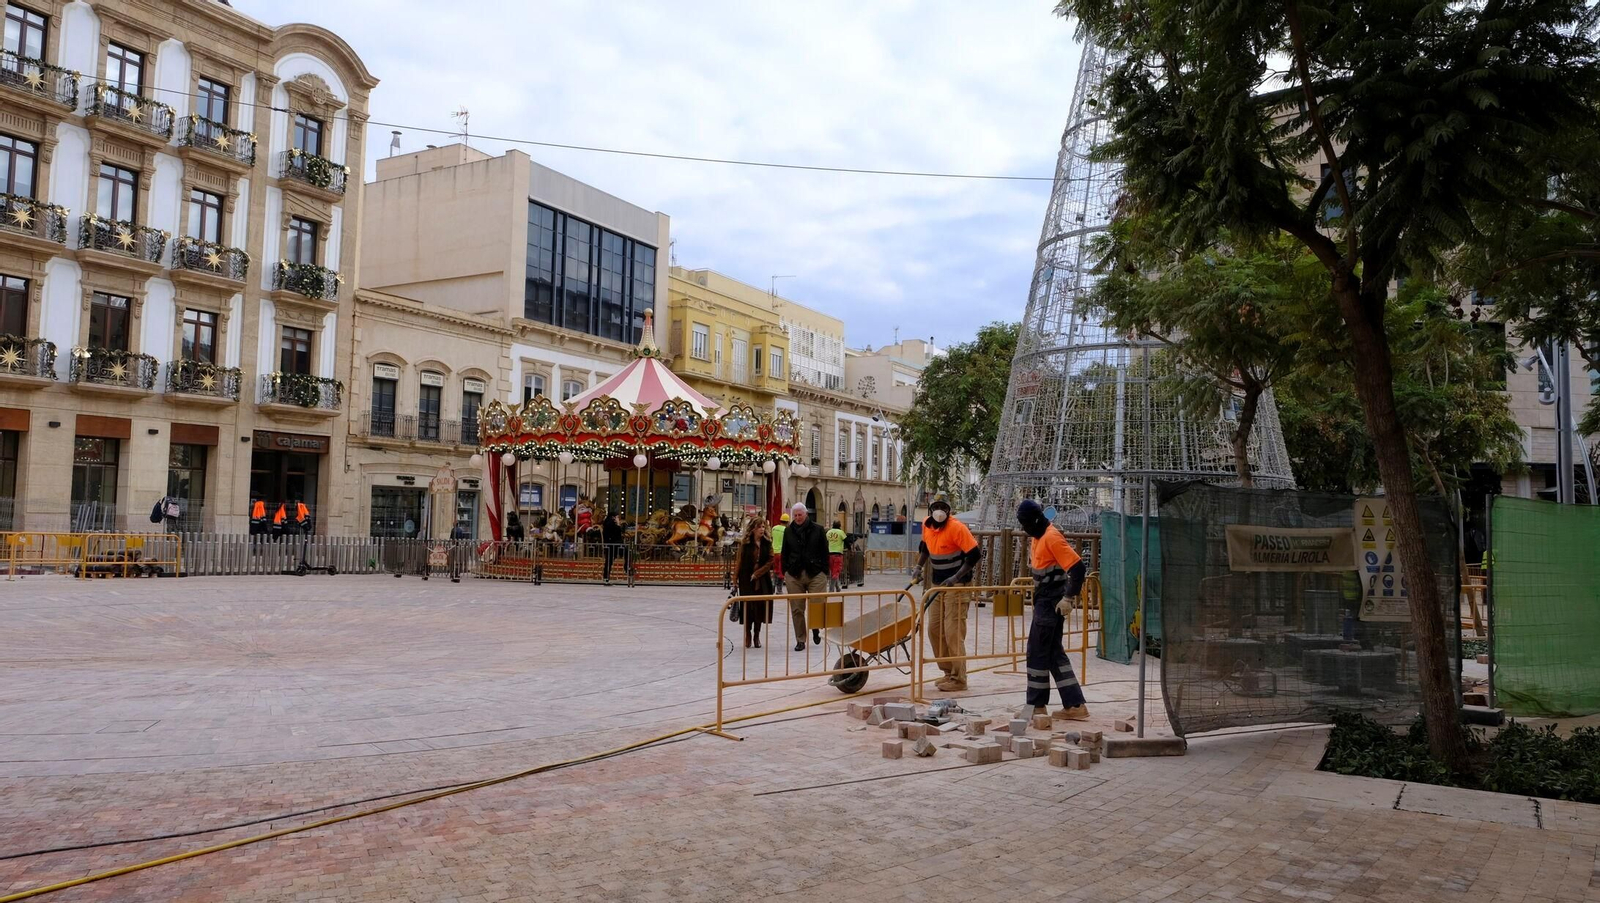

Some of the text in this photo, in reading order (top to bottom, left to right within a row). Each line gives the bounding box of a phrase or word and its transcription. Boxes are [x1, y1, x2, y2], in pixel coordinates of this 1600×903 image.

[276, 435, 325, 451] cajamar
[1254, 534, 1290, 551] PASEO
[1253, 550, 1331, 564] ALMERÍA LIROLA
